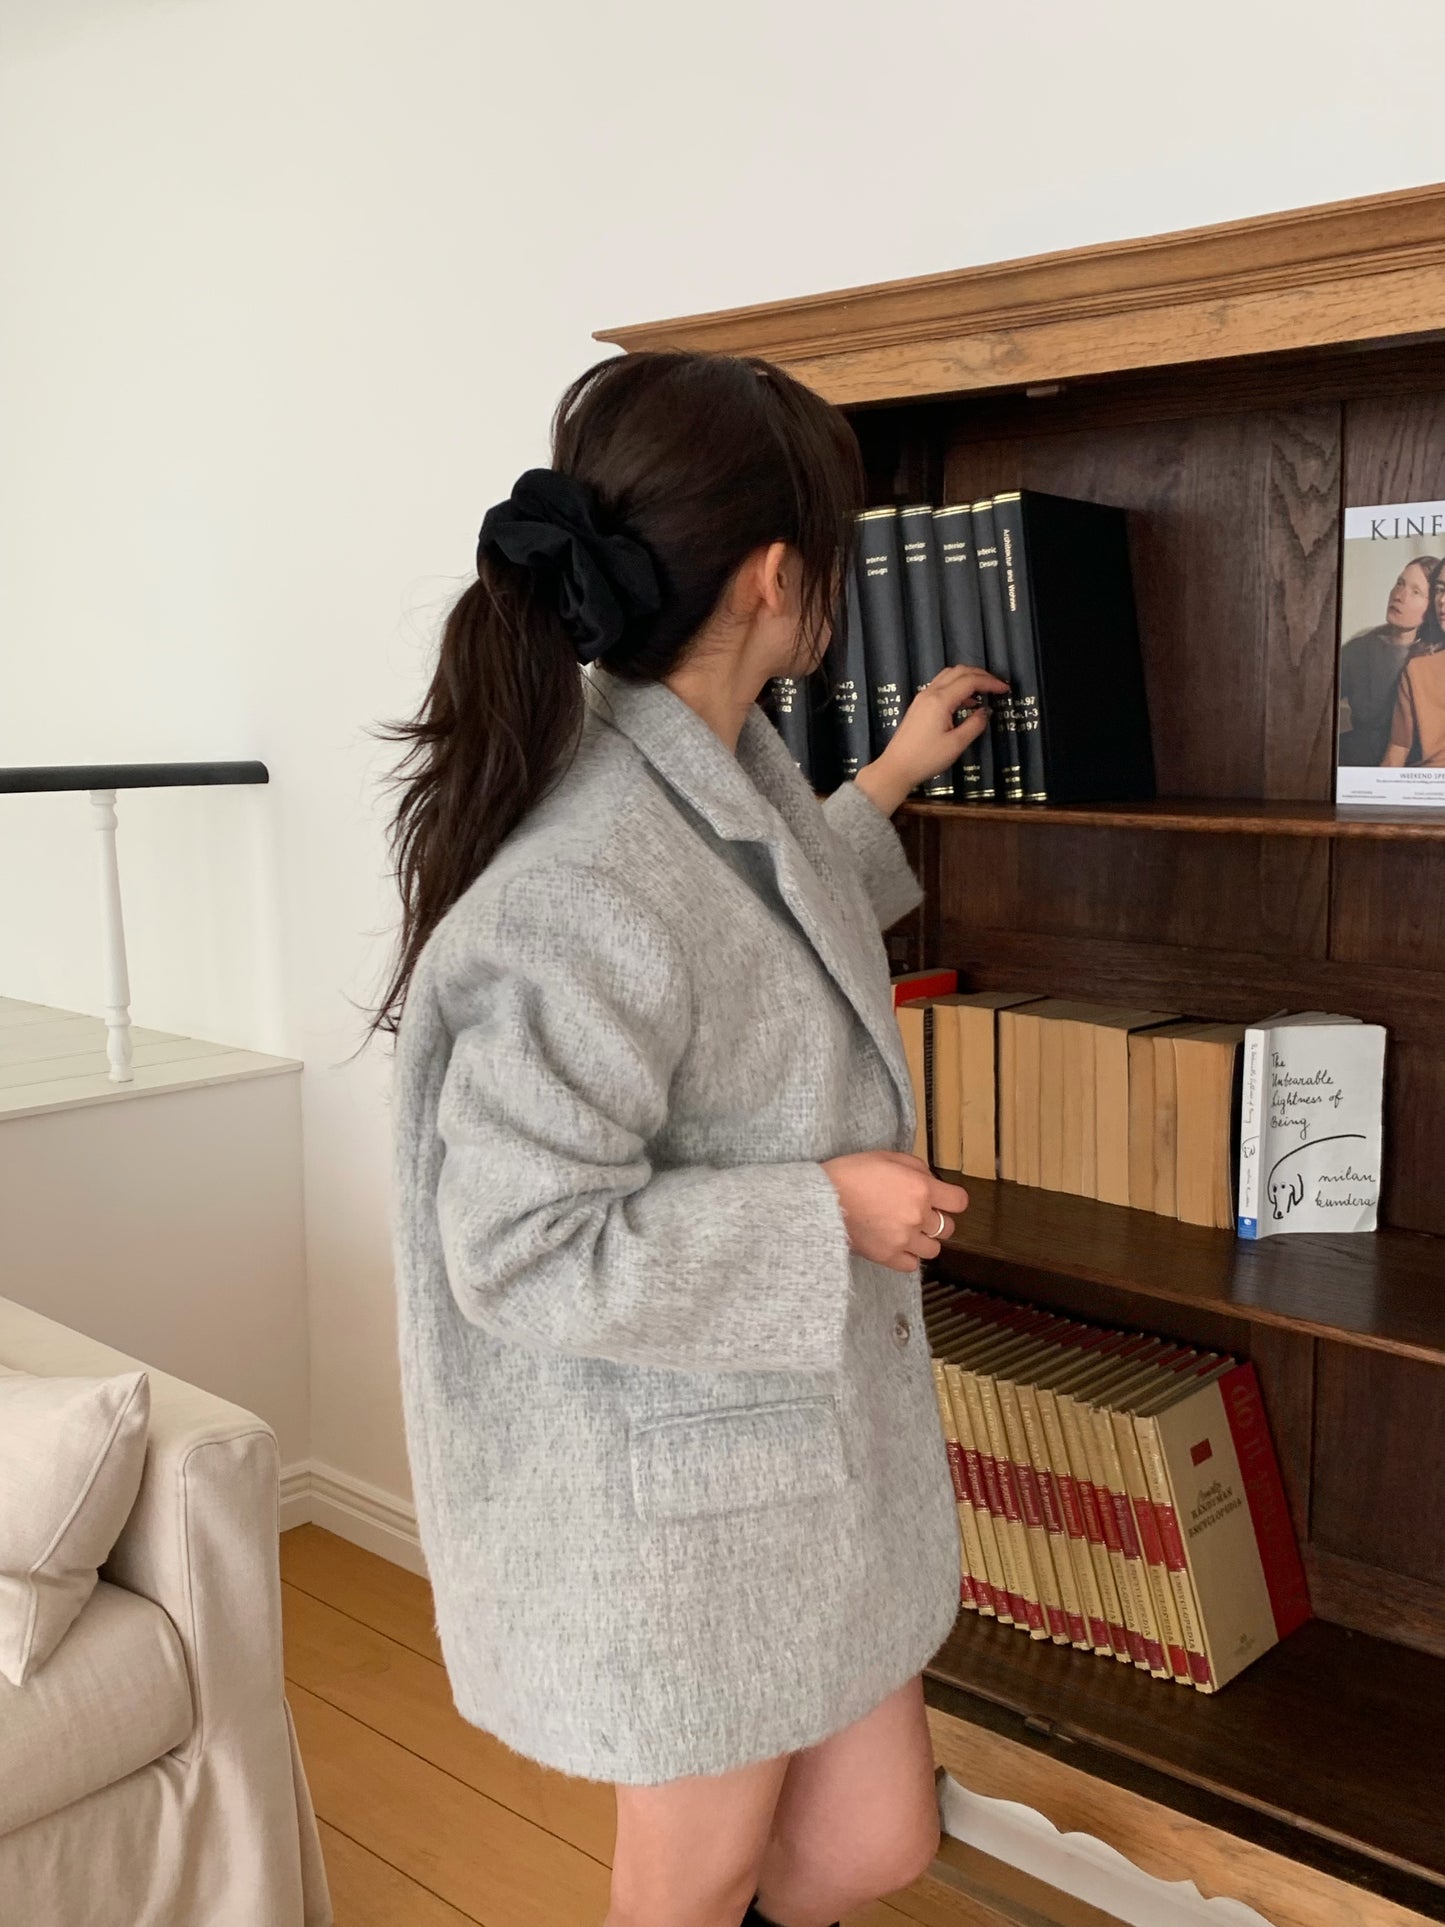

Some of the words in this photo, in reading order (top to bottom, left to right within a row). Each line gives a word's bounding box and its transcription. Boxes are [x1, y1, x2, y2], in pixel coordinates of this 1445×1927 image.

[1370, 515, 1443, 541] KINF
[943, 541, 966, 551] Interior
[906, 554, 927, 563] Design
[945, 554, 967, 563] Design
[867, 567, 888, 577] Design
[1271, 1051, 1285, 1068] The
[1271, 1070, 1334, 1088] Unbearable
[1328, 1089, 1344, 1109] of
[1270, 1116, 1311, 1140] Being
[1188, 1497, 1242, 1538] ENCYCLOPEDIA
